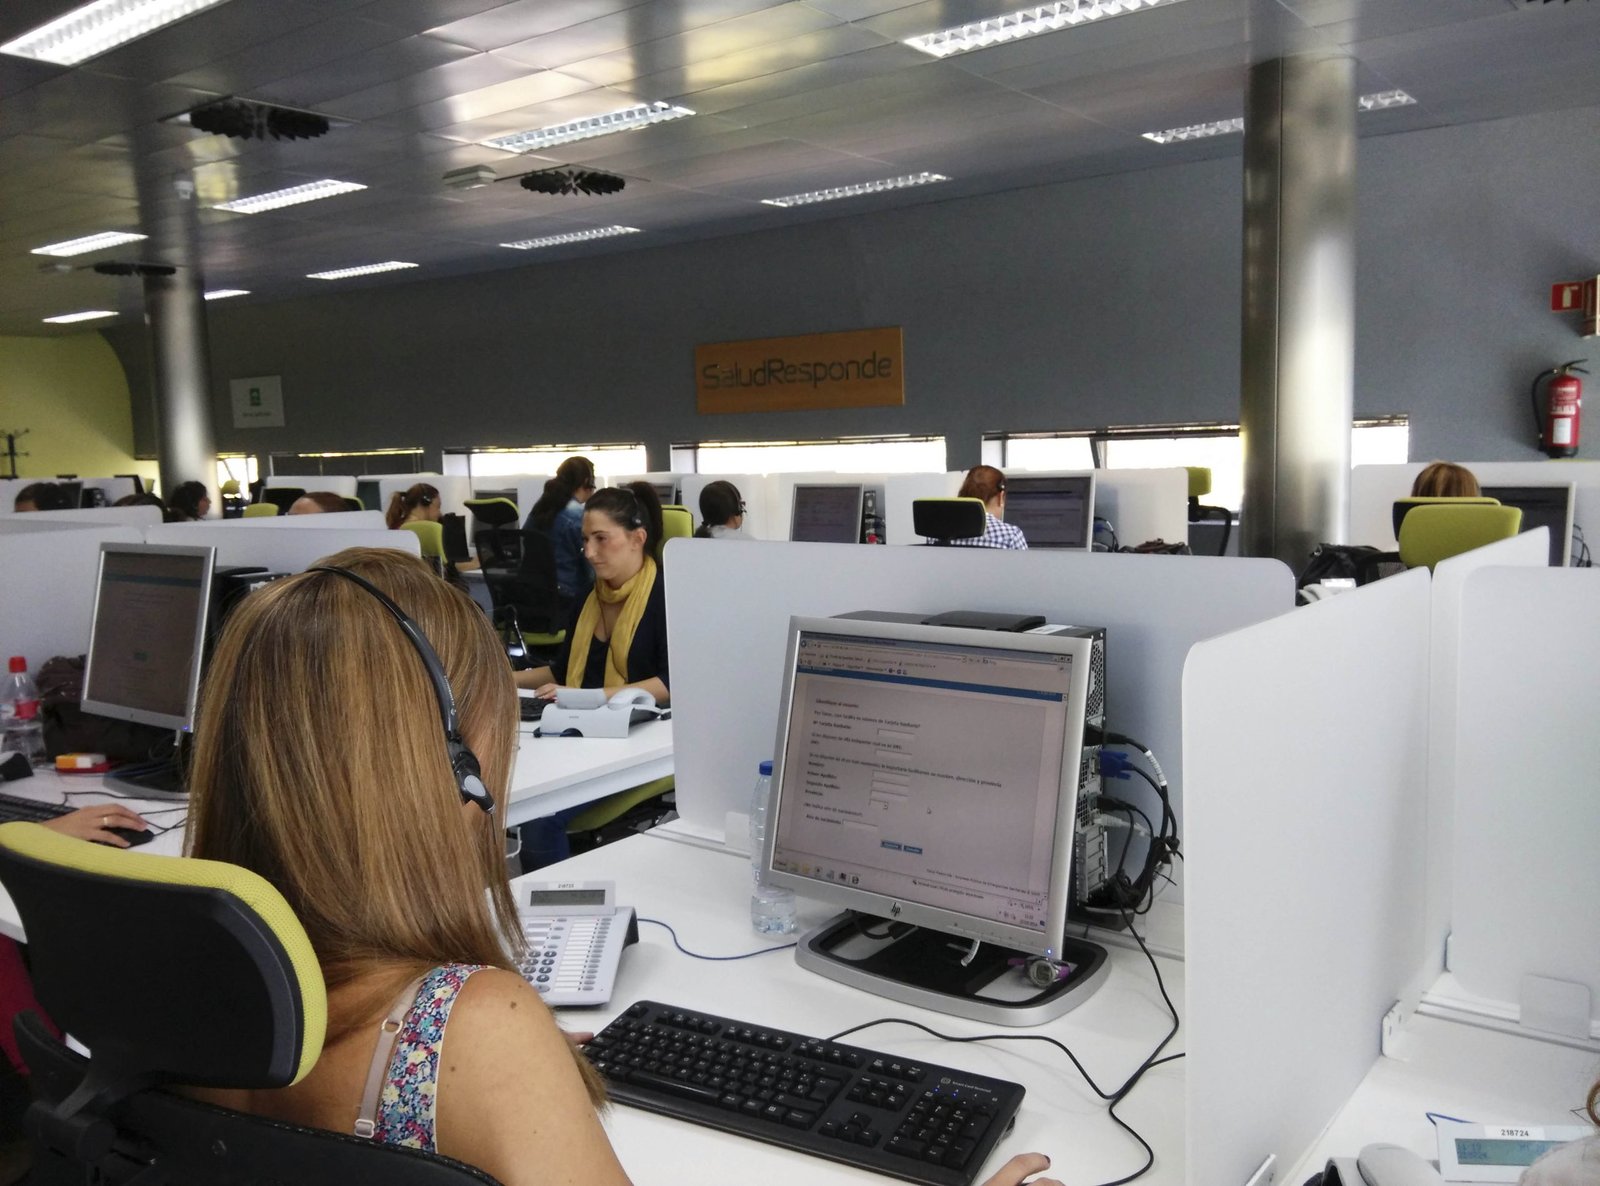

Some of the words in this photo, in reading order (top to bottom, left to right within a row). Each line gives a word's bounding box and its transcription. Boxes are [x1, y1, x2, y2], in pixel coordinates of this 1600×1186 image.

[702, 352, 892, 389] SaludResponde
[891, 902, 901, 917] hp
[1501, 1129, 1529, 1137] 218724
